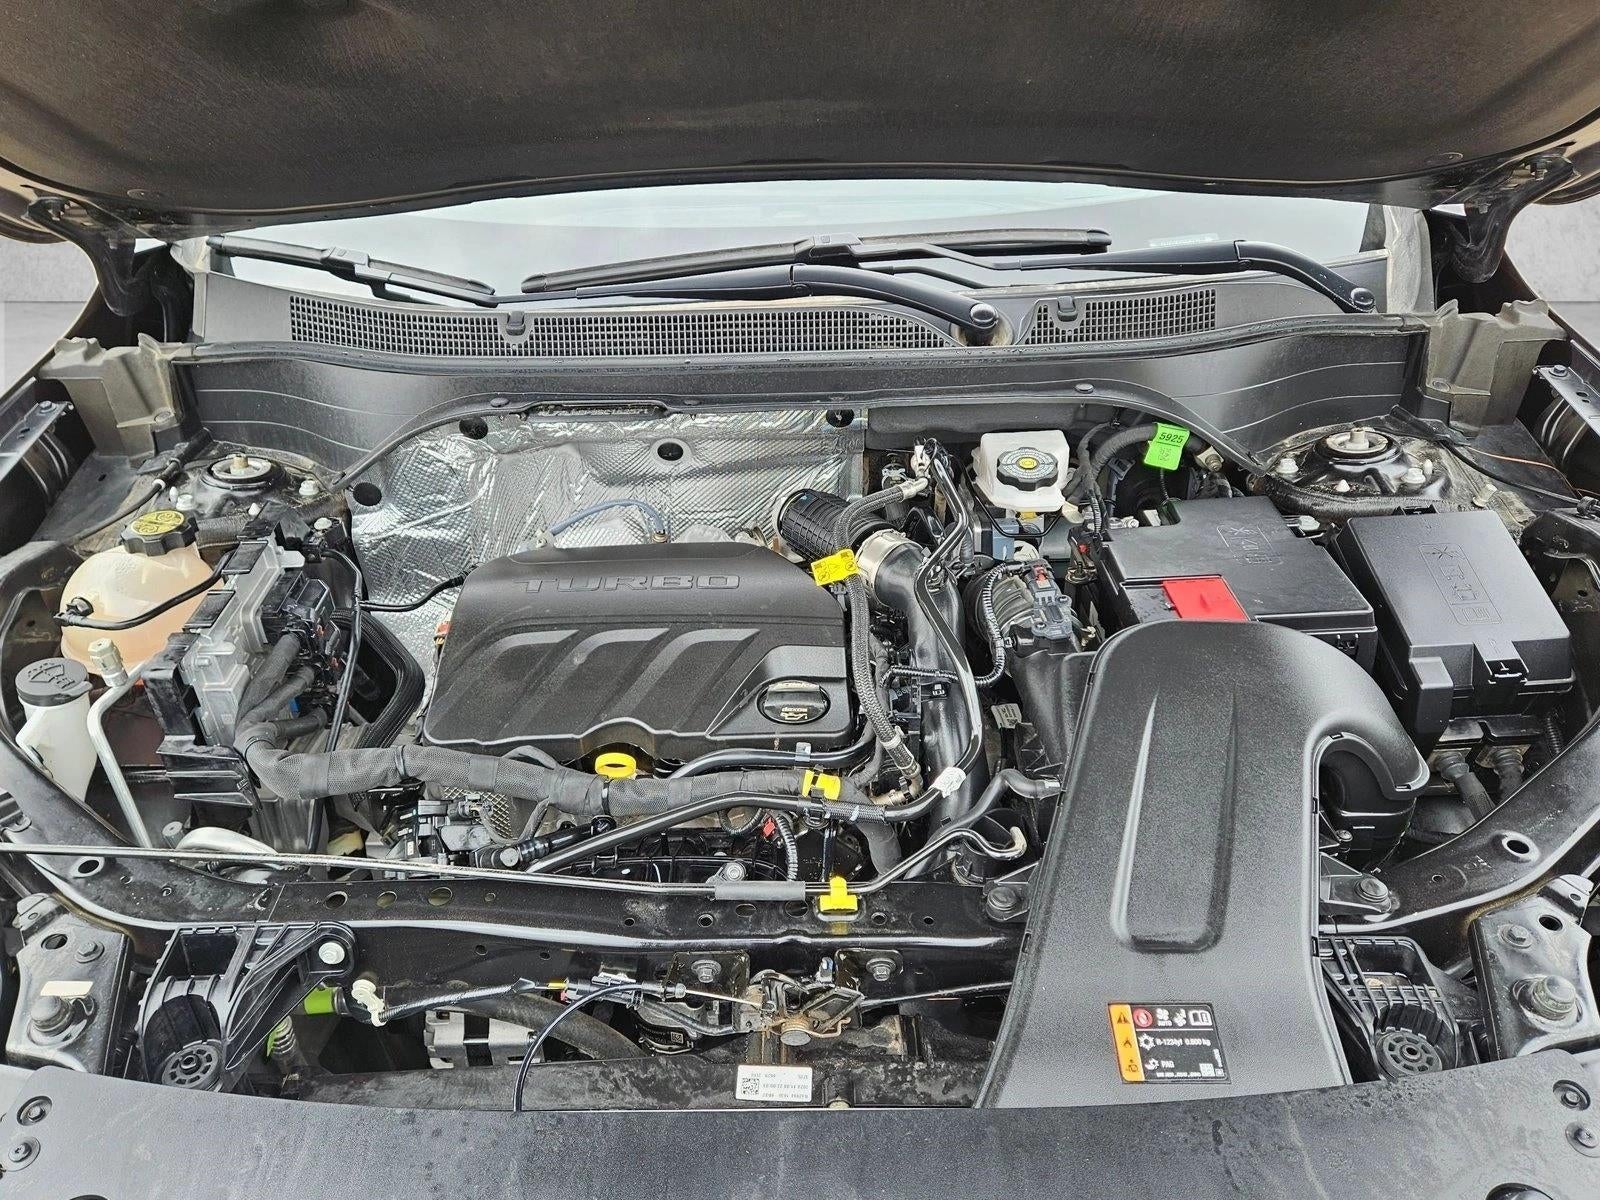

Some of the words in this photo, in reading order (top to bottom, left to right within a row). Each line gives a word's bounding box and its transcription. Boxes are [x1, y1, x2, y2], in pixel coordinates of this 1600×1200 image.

[1159, 432, 1184, 444] 5925
[513, 575, 740, 593] TURBO
[1160, 1060, 1175, 1069] PAG
